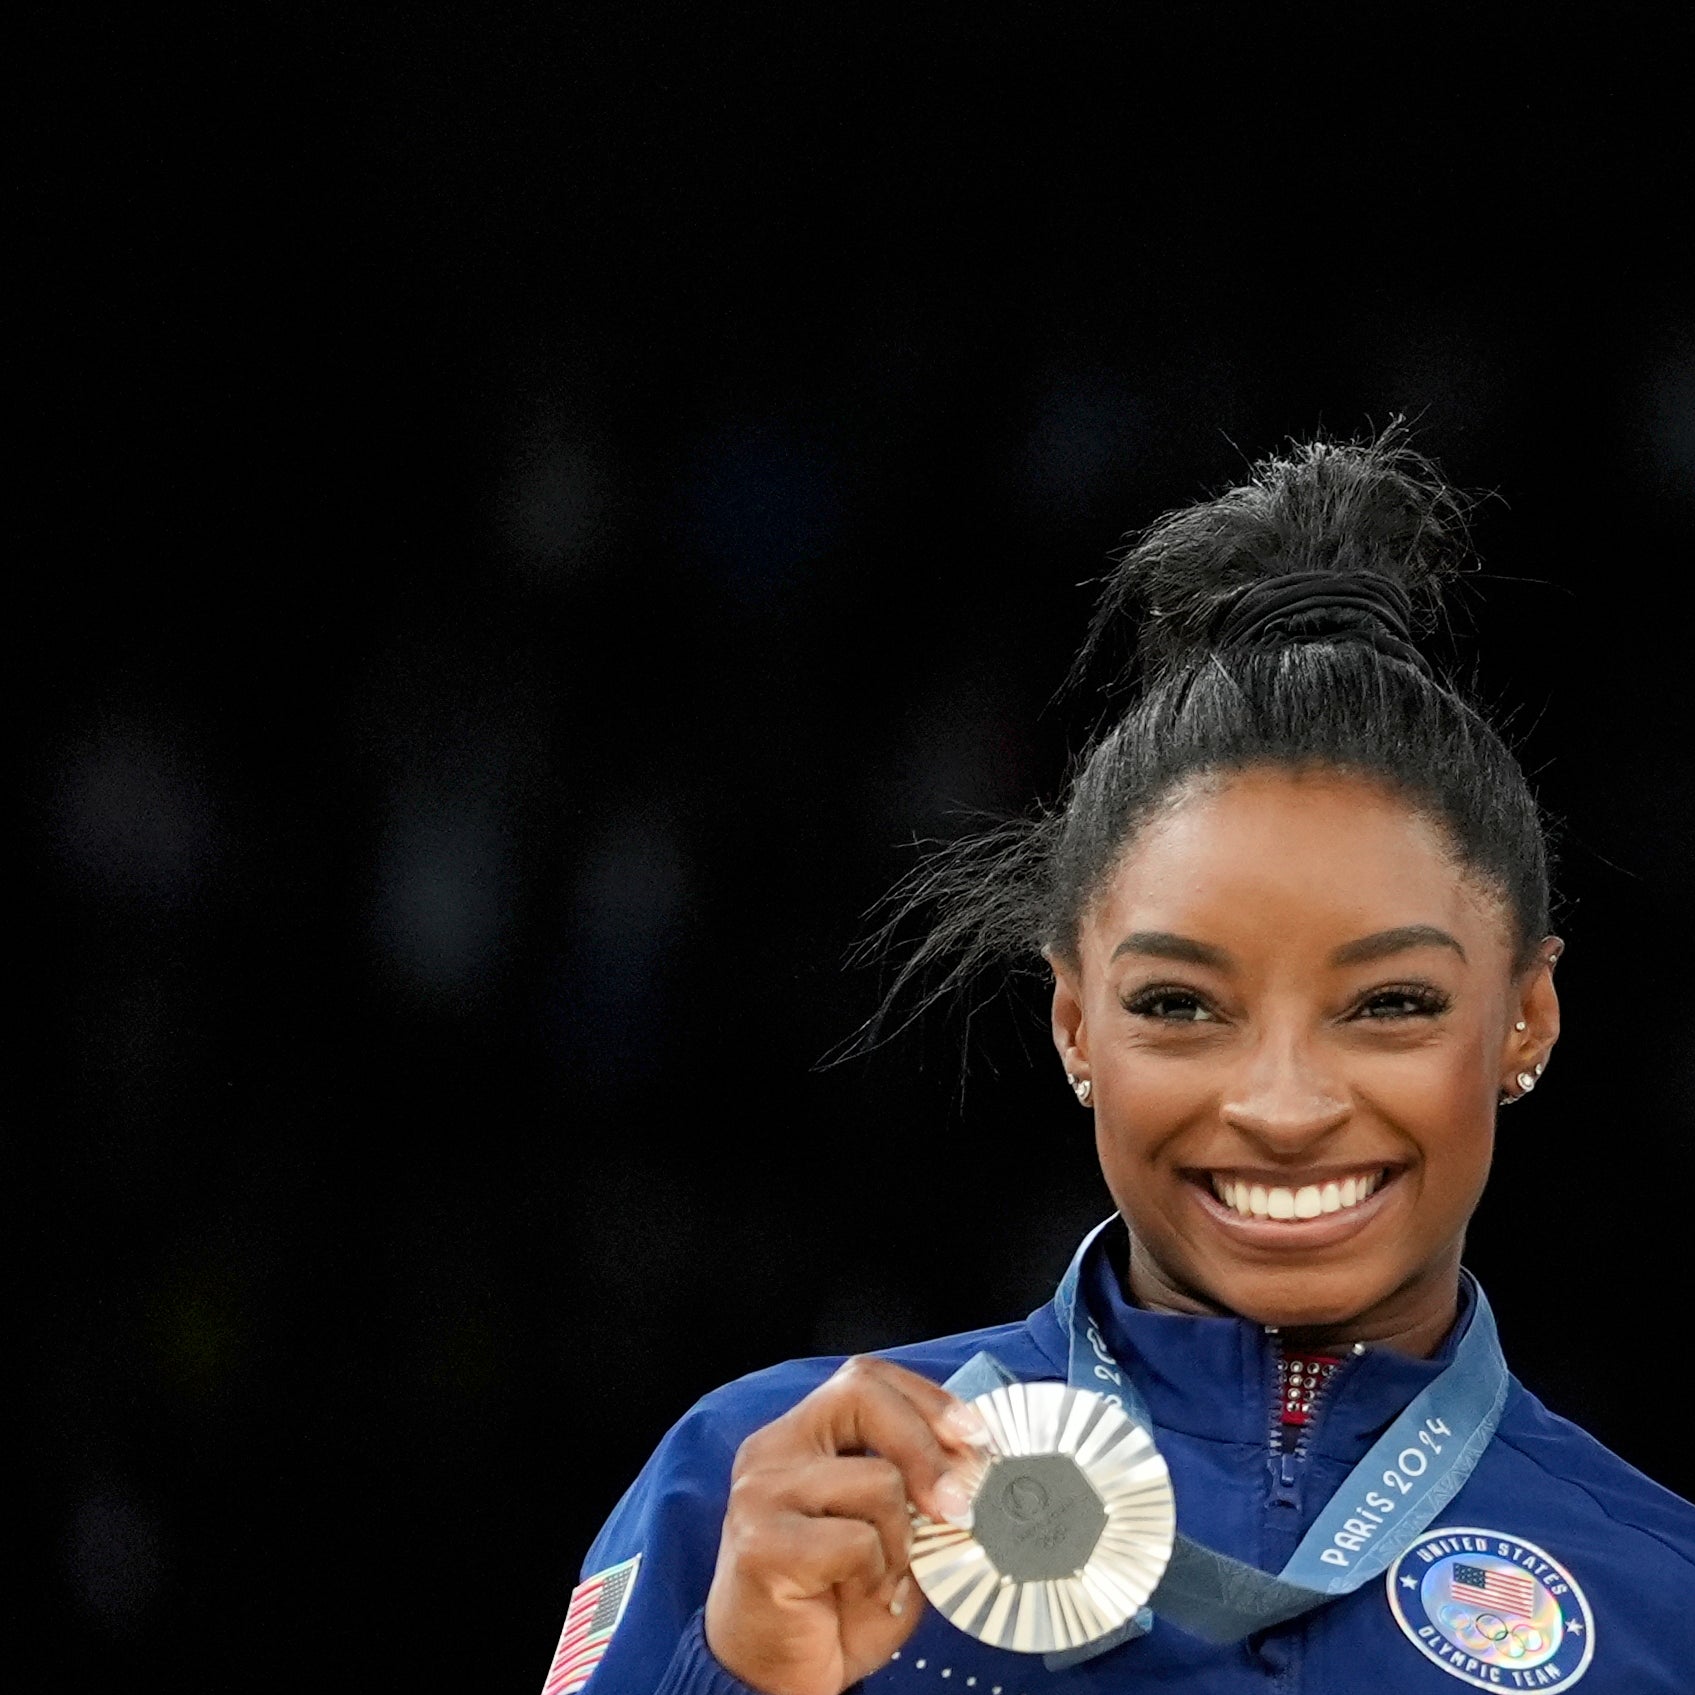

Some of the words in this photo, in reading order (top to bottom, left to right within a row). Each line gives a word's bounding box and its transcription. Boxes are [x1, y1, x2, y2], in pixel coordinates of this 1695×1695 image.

[1382, 1417, 1451, 1495] 2024
[1416, 1537, 1488, 1563] UNITED
[1497, 1542, 1568, 1596] STATES
[1418, 1625, 1500, 1682] OLYMPIC
[1512, 1663, 1562, 1687] TEAM
